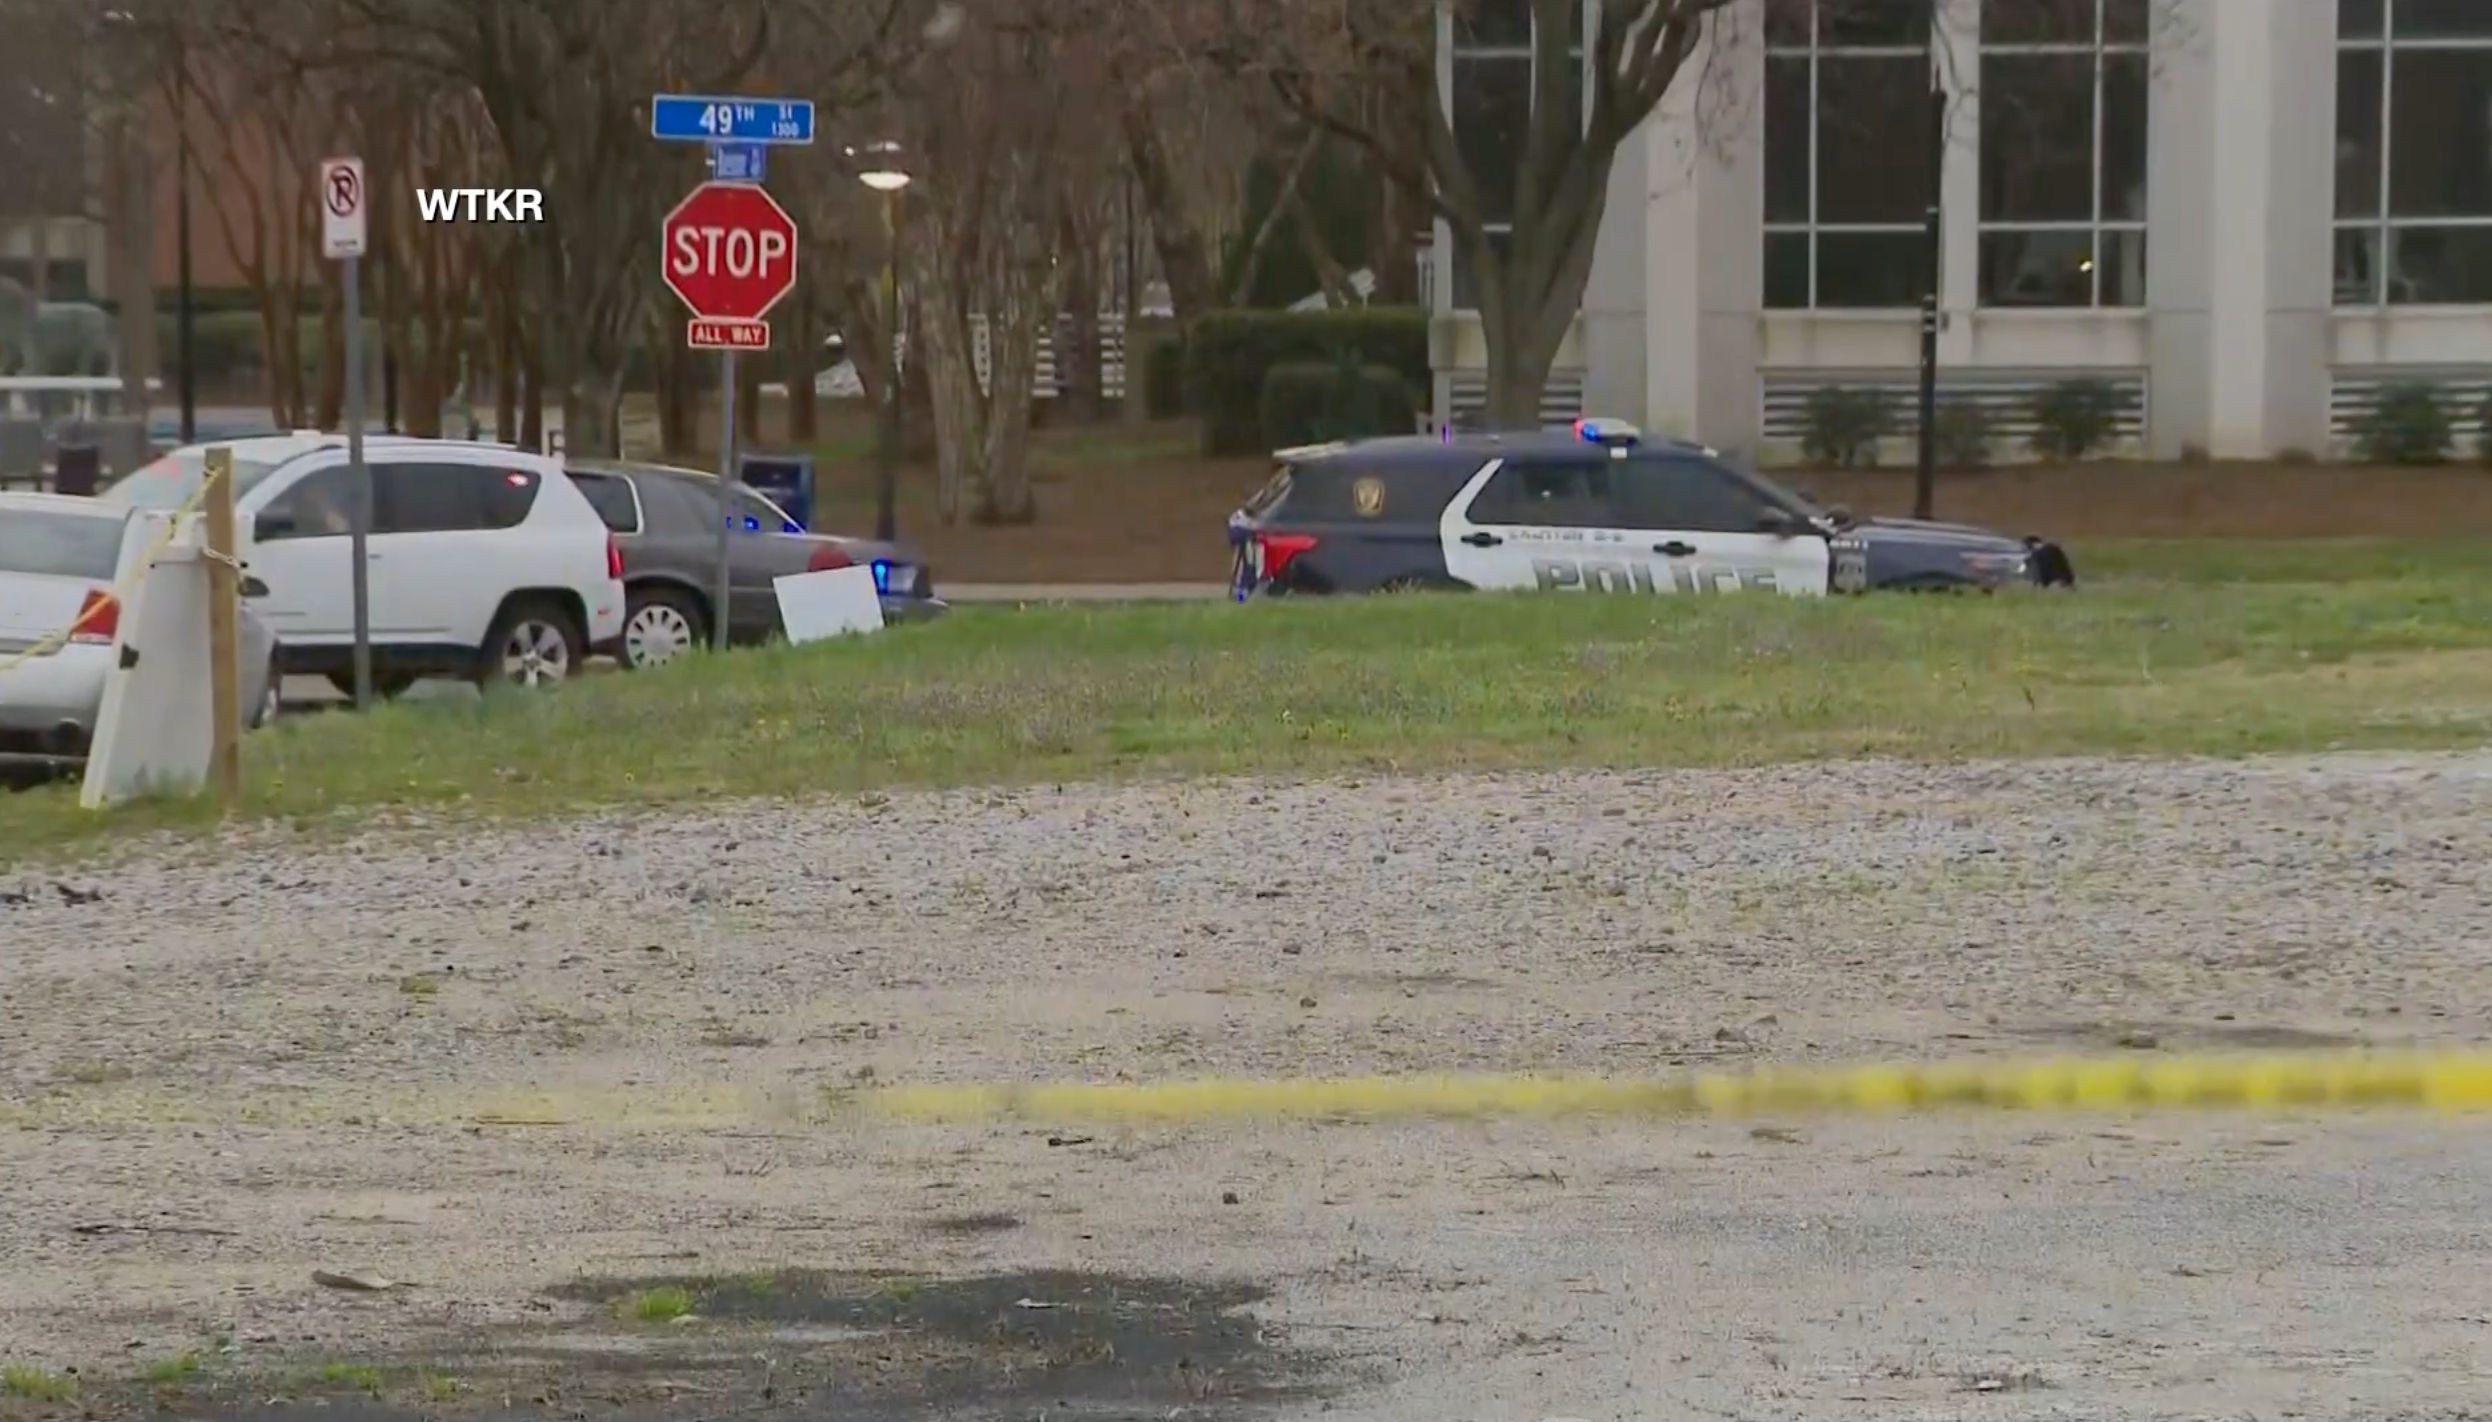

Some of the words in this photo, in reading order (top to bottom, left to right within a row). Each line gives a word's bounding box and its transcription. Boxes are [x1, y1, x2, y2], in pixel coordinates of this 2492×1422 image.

[673, 226, 787, 279] STOP
[695, 325, 723, 342] ALL
[731, 326, 762, 344] WAY
